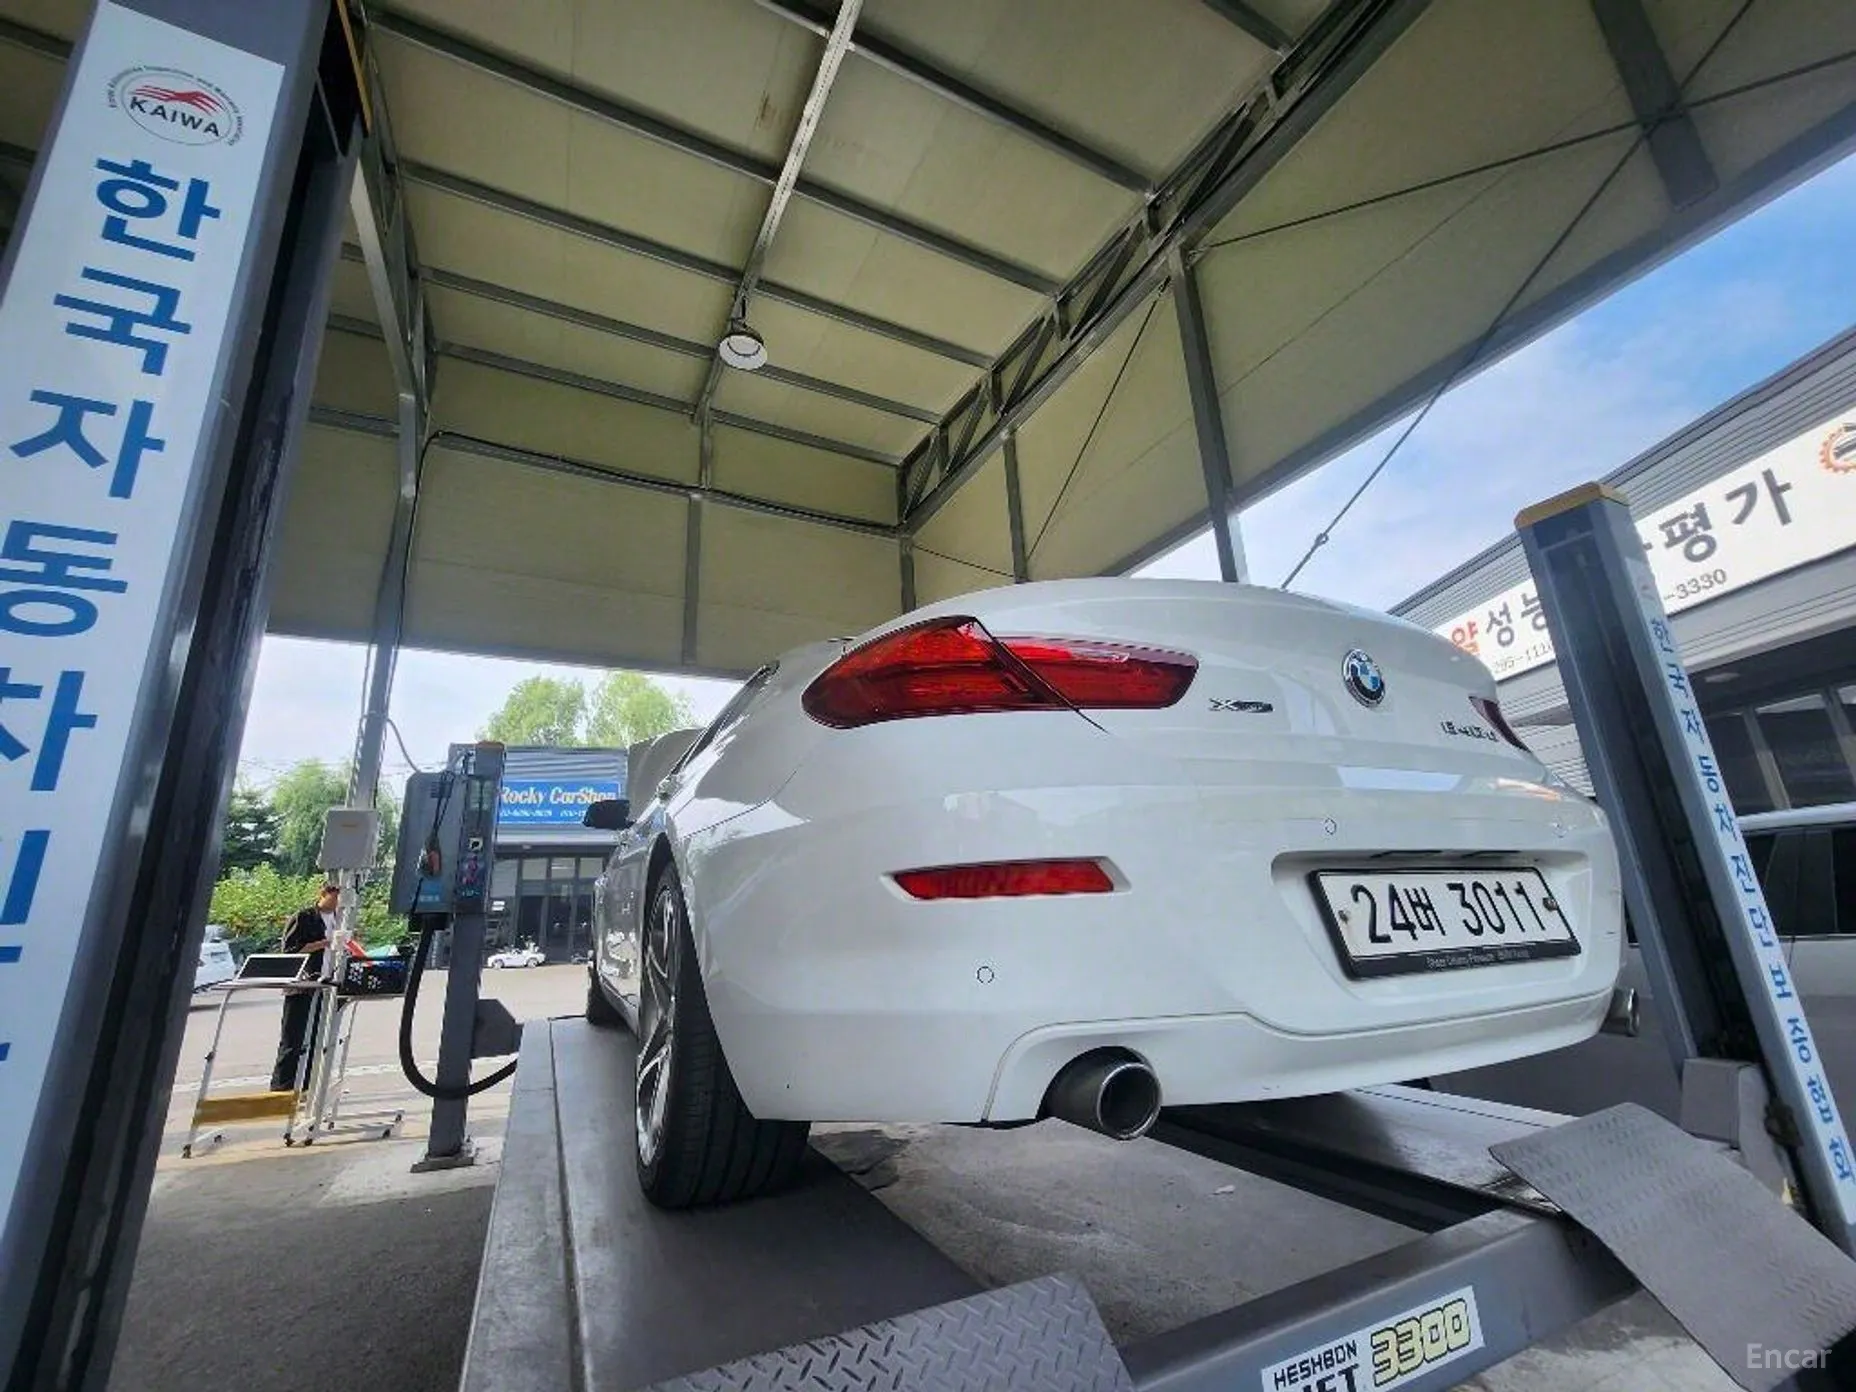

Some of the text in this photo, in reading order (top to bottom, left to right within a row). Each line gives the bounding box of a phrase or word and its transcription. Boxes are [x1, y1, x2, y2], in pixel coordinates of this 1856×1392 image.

[130, 96, 220, 137] KAIWA
[1446, 880, 1547, 937] 3011
[1273, 1340, 1358, 1391] HESHBON
[1369, 1298, 1471, 1388] 3300
